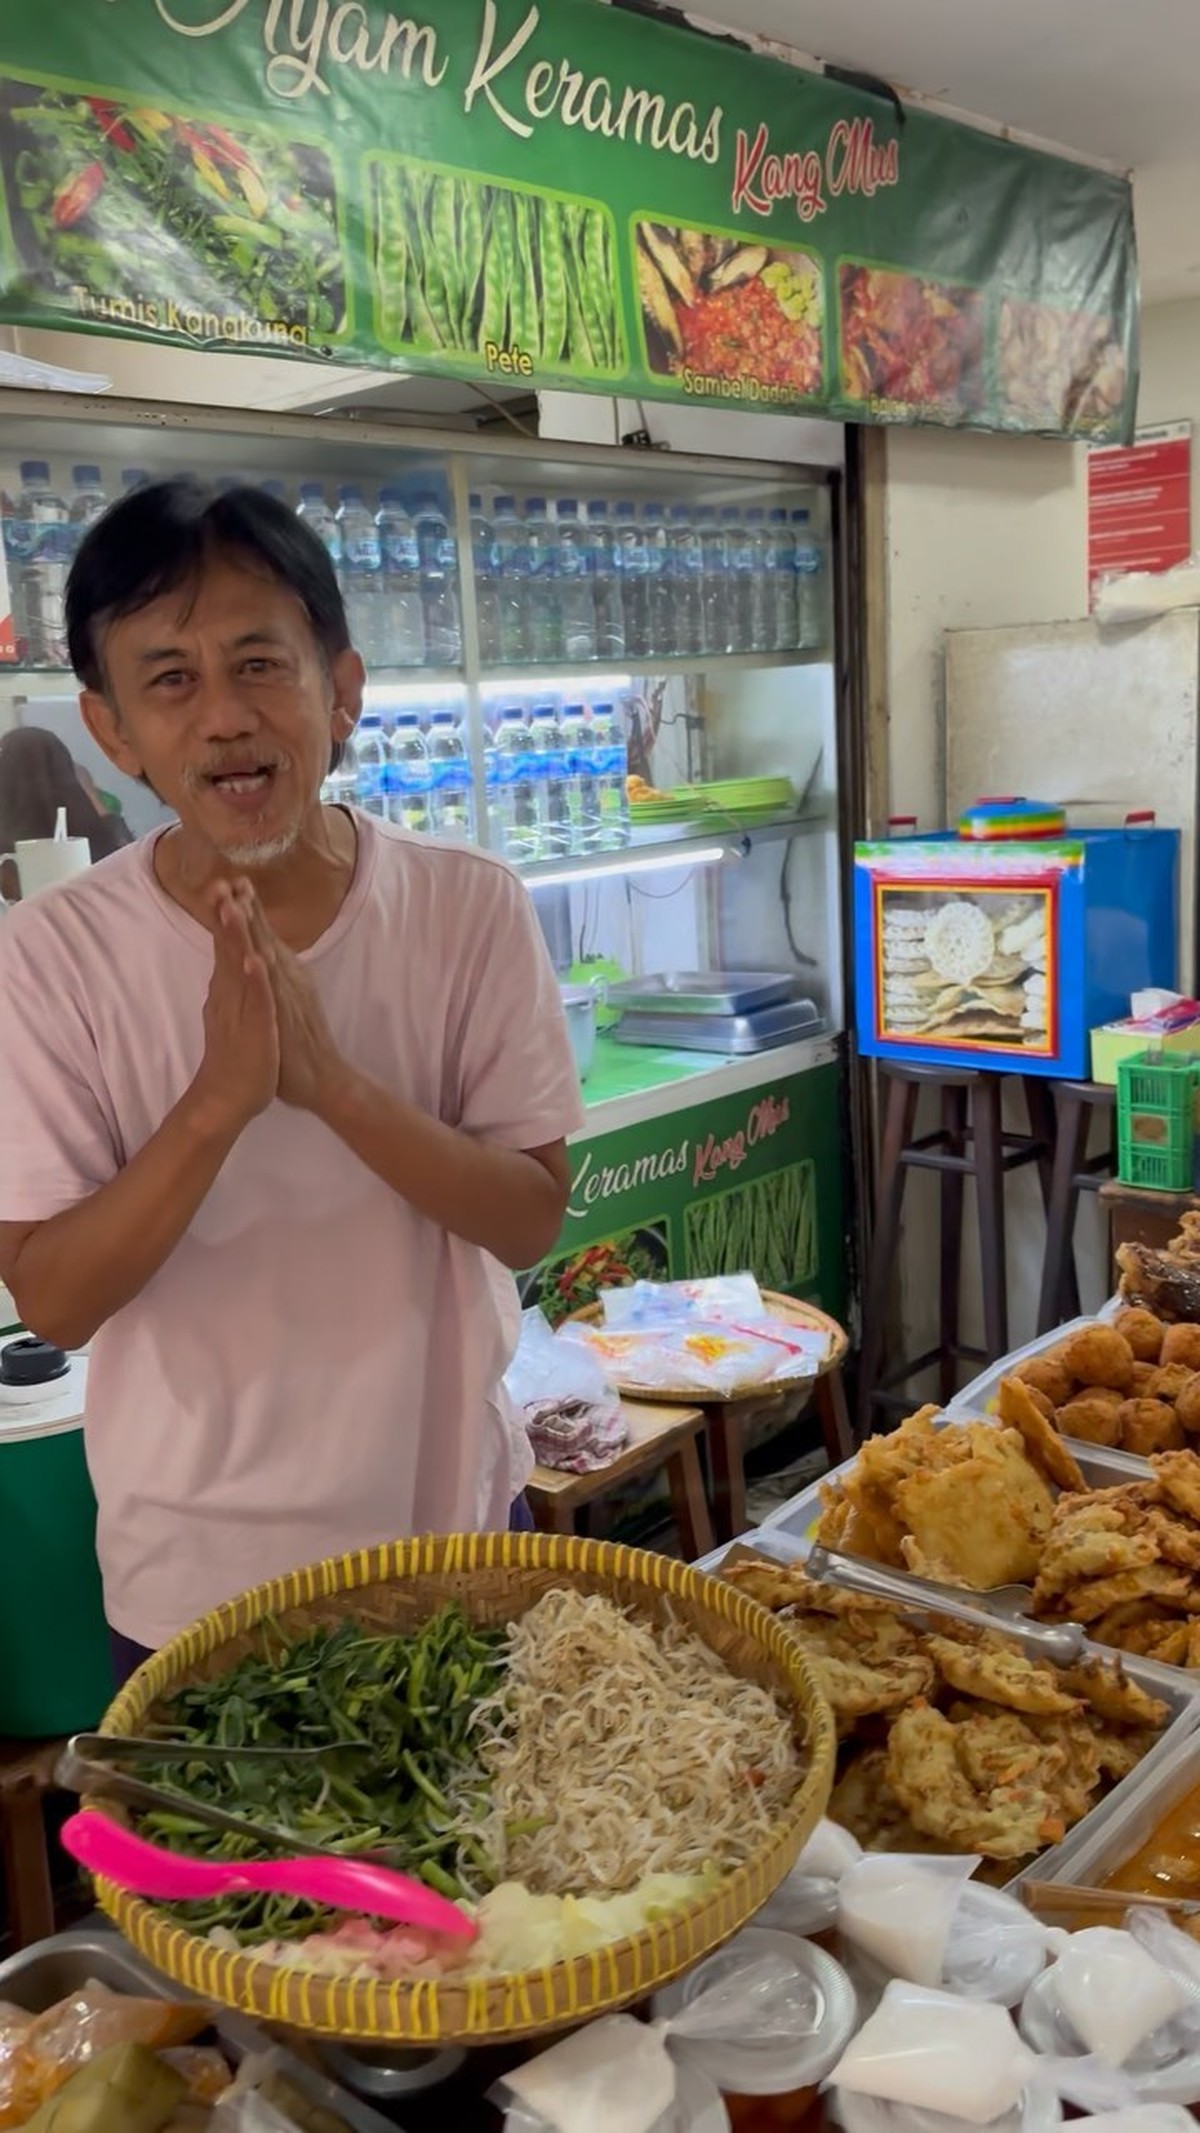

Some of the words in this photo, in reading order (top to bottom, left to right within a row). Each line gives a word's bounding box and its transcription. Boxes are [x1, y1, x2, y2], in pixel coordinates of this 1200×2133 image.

[464, 0, 724, 164] Keramas
[732, 122, 828, 223] Kang
[72, 285, 158, 327] Tumis
[485, 342, 534, 376] Pete
[692, 1133, 747, 1188] Kang
